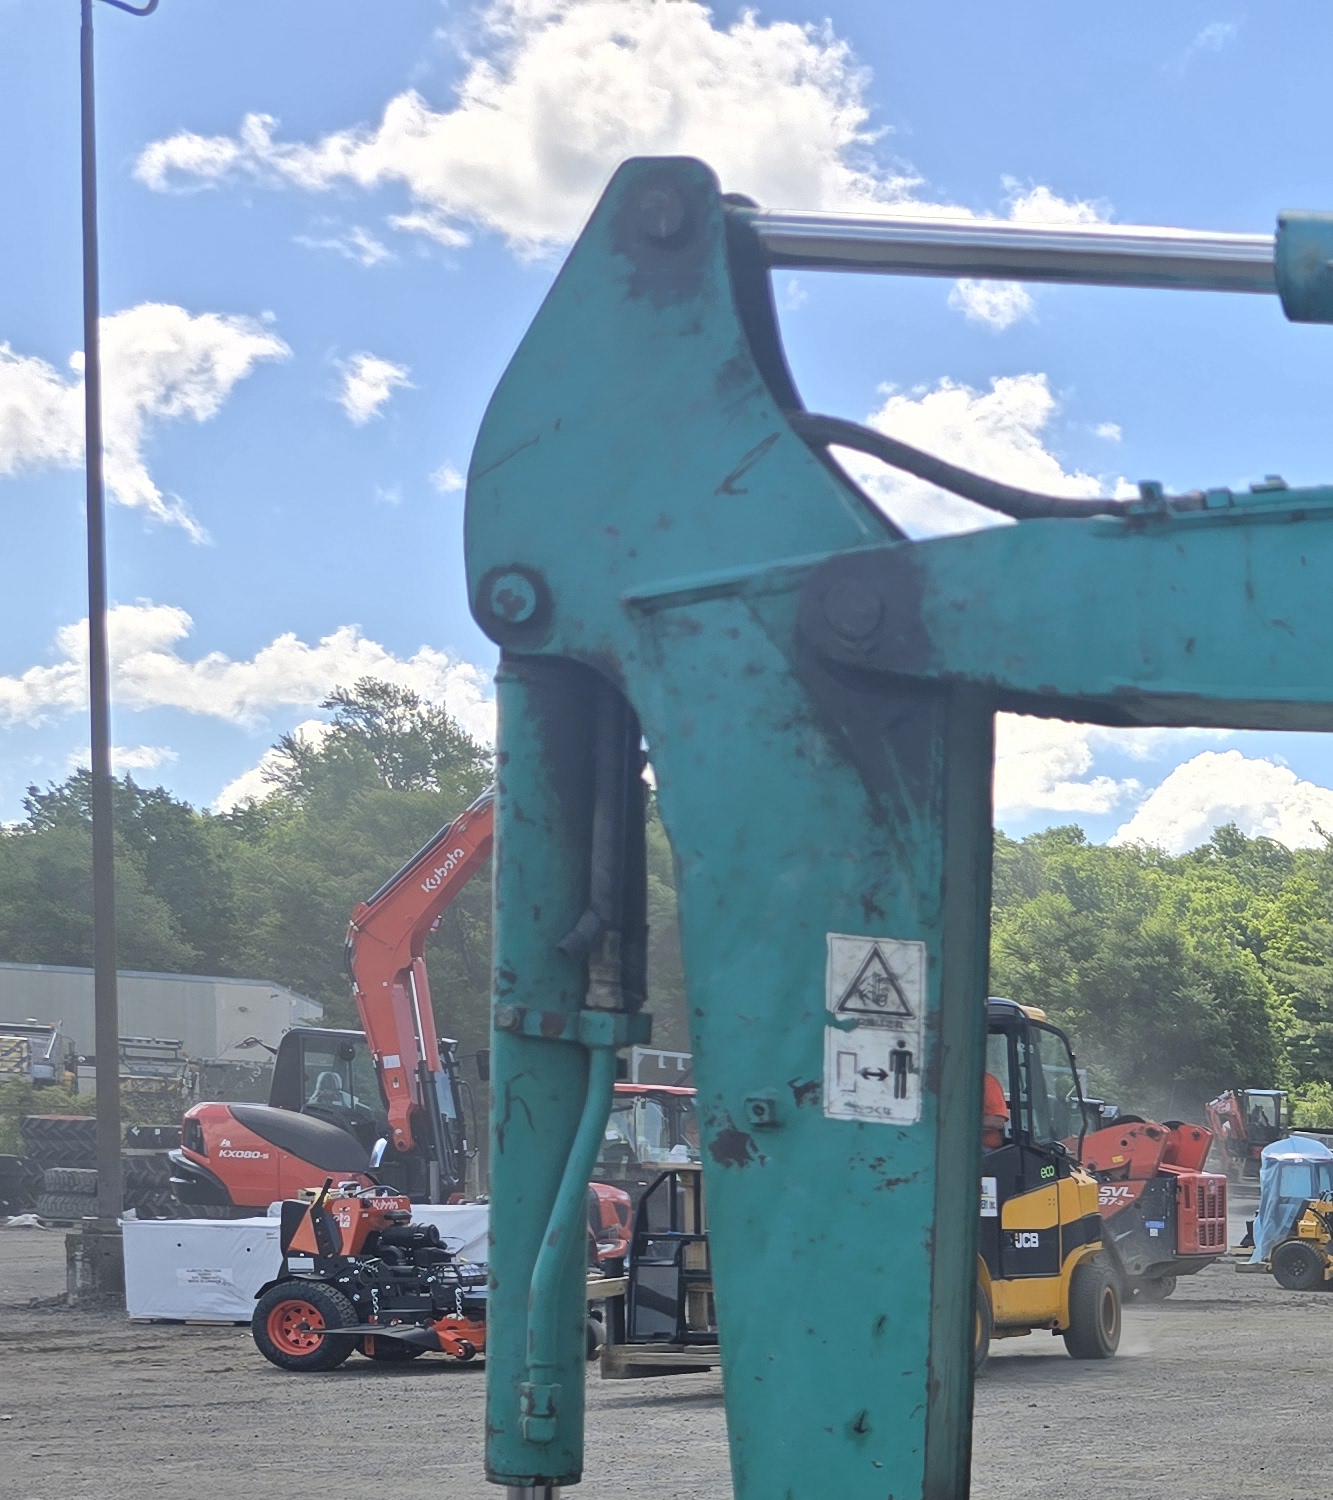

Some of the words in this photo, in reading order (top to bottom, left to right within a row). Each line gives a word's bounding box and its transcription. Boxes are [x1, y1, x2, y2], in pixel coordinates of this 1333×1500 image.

[421, 848, 465, 893] Kubota
[1040, 1165, 1055, 1178] eco
[1098, 1186, 1135, 1197] SVL
[1014, 1232, 1039, 1248] JCB
